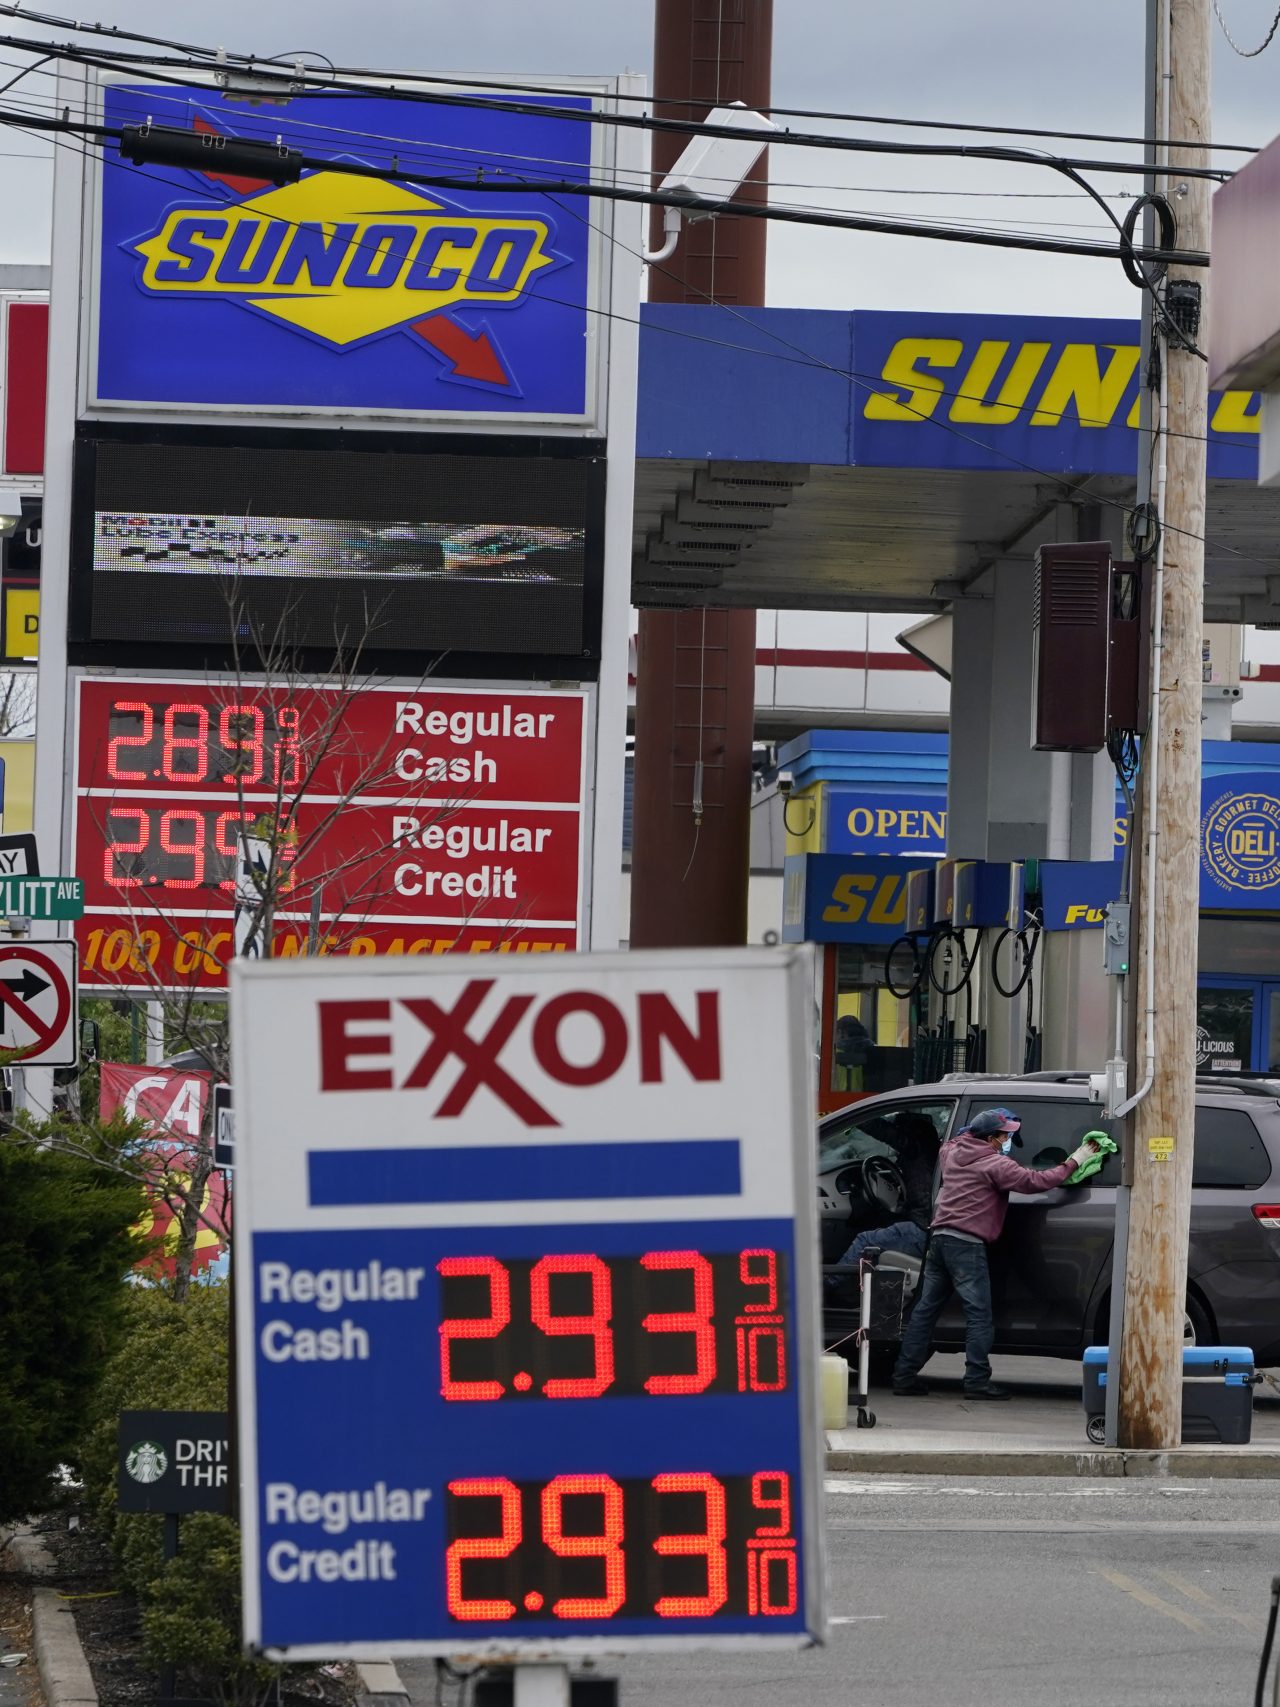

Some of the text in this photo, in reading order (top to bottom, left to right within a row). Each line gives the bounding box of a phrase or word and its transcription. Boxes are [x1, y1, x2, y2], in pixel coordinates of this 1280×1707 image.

[154, 218, 538, 292] SUNOCO
[102, 526, 299, 543] Lube Express
[394, 702, 555, 748] Regular
[394, 748, 498, 784] Cash
[392, 815, 552, 858] Regular
[847, 807, 946, 839] OPEN
[1214, 799, 1258, 833] GOURMET
[393, 861, 517, 899] Credit
[1212, 841, 1239, 878] BAKERY
[57, 881, 81, 900] AVE
[82, 928, 161, 973] 100
[316, 978, 721, 1128] EXXON
[258, 1250, 718, 1402] Regular 2.93
[260, 1319, 370, 1363] Cash
[175, 1464, 228, 1488] THR
[264, 1472, 729, 1622] Regular 2.93
[266, 1542, 397, 1584] Credit
